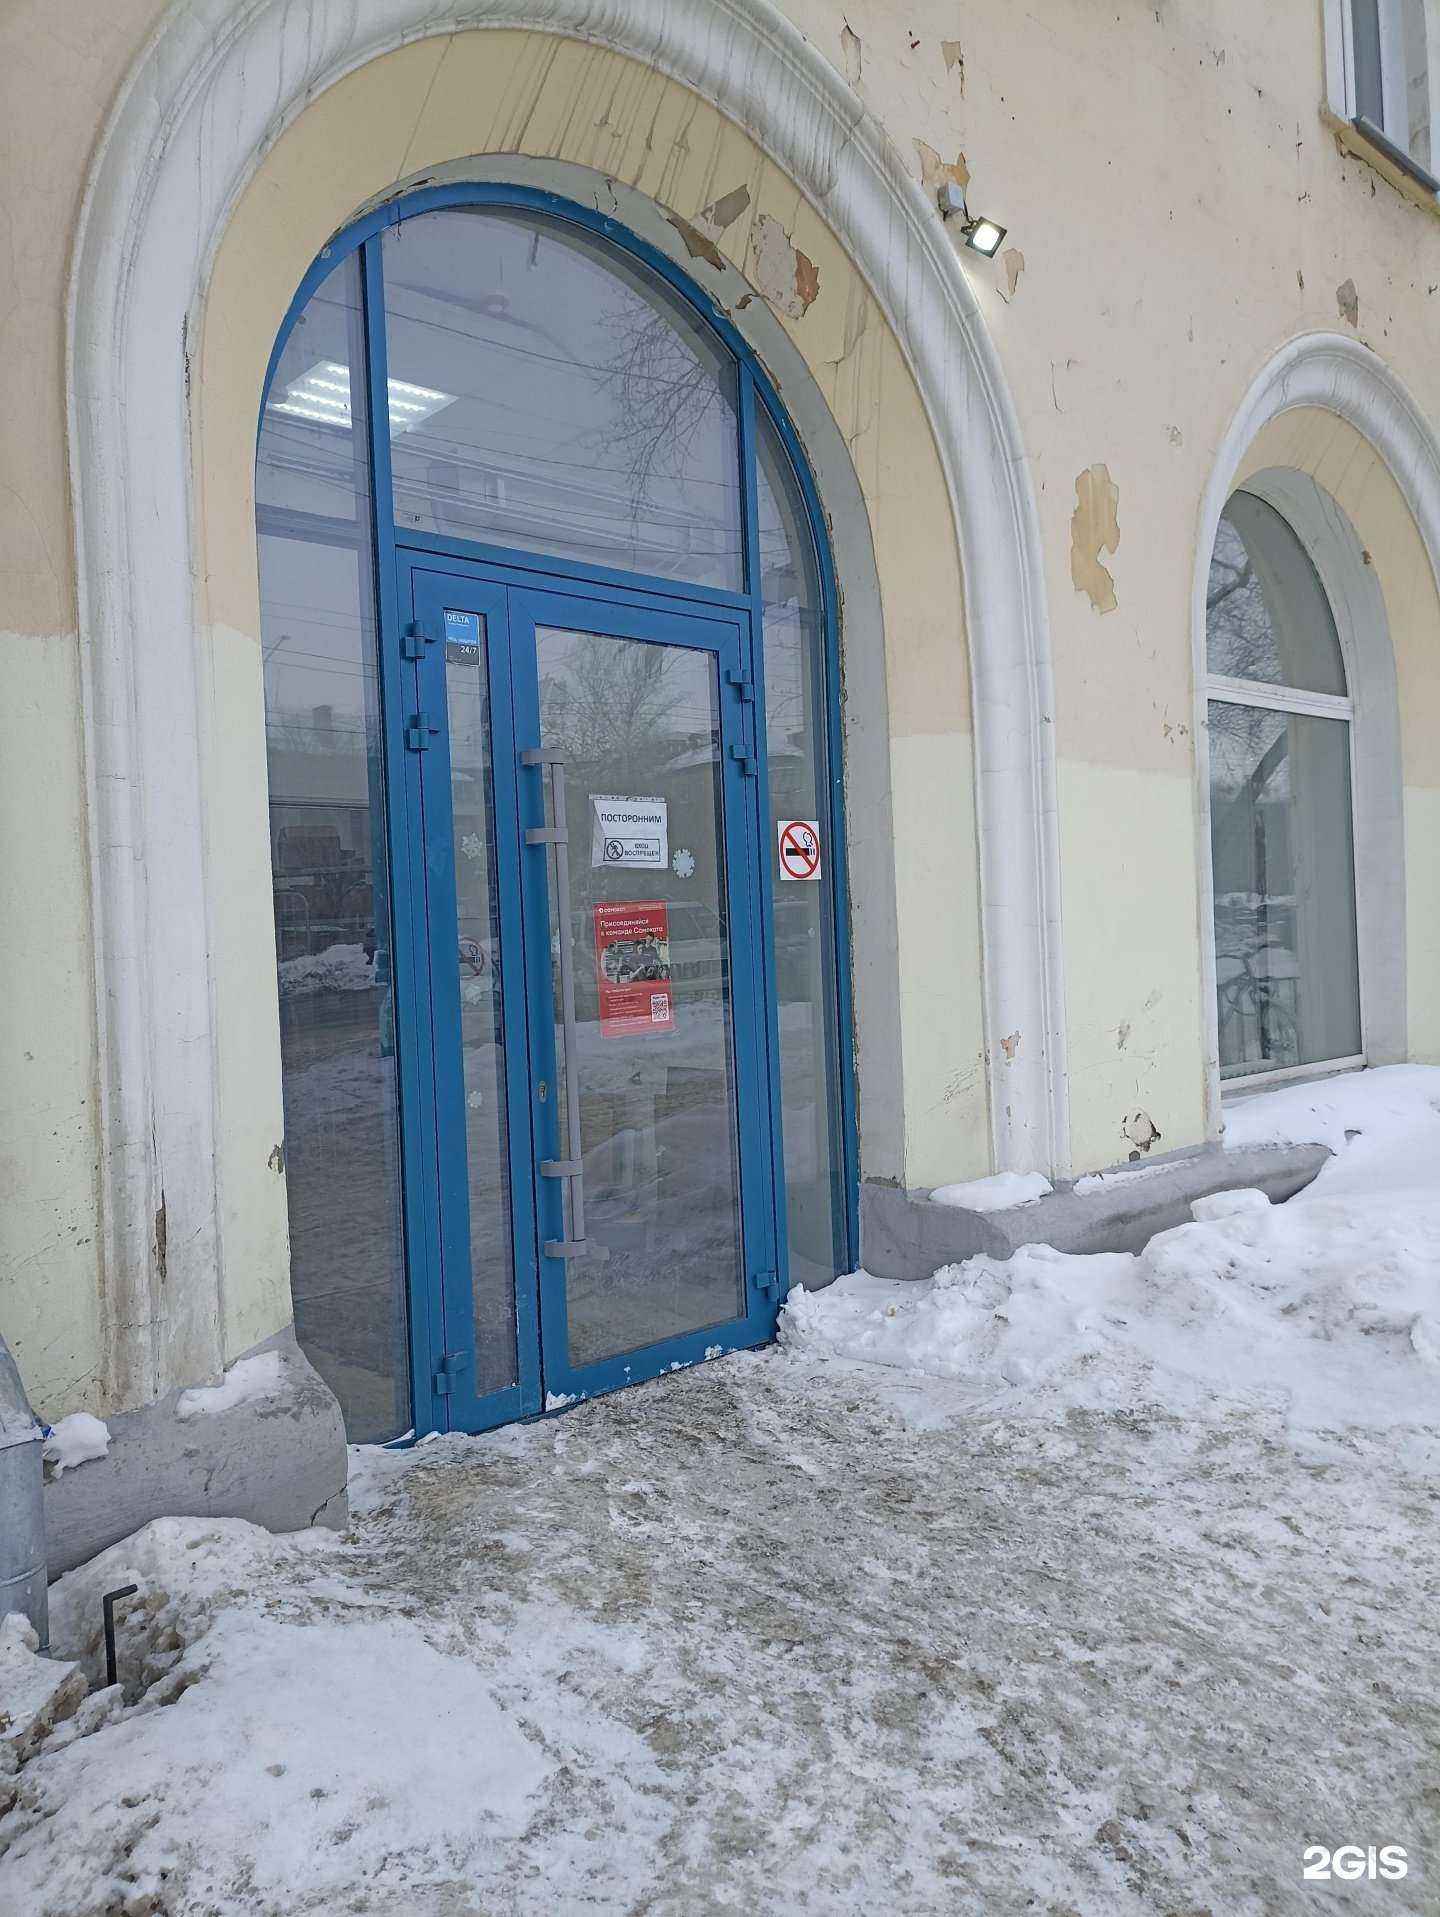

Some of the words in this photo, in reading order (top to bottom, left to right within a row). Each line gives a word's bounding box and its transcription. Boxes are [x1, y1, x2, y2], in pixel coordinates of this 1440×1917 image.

[447, 613, 470, 624] DELTA
[460, 645, 477, 654] 24/7
[601, 813, 662, 824] ПОСТОРОННИМ
[633, 926, 664, 935] Самоката
